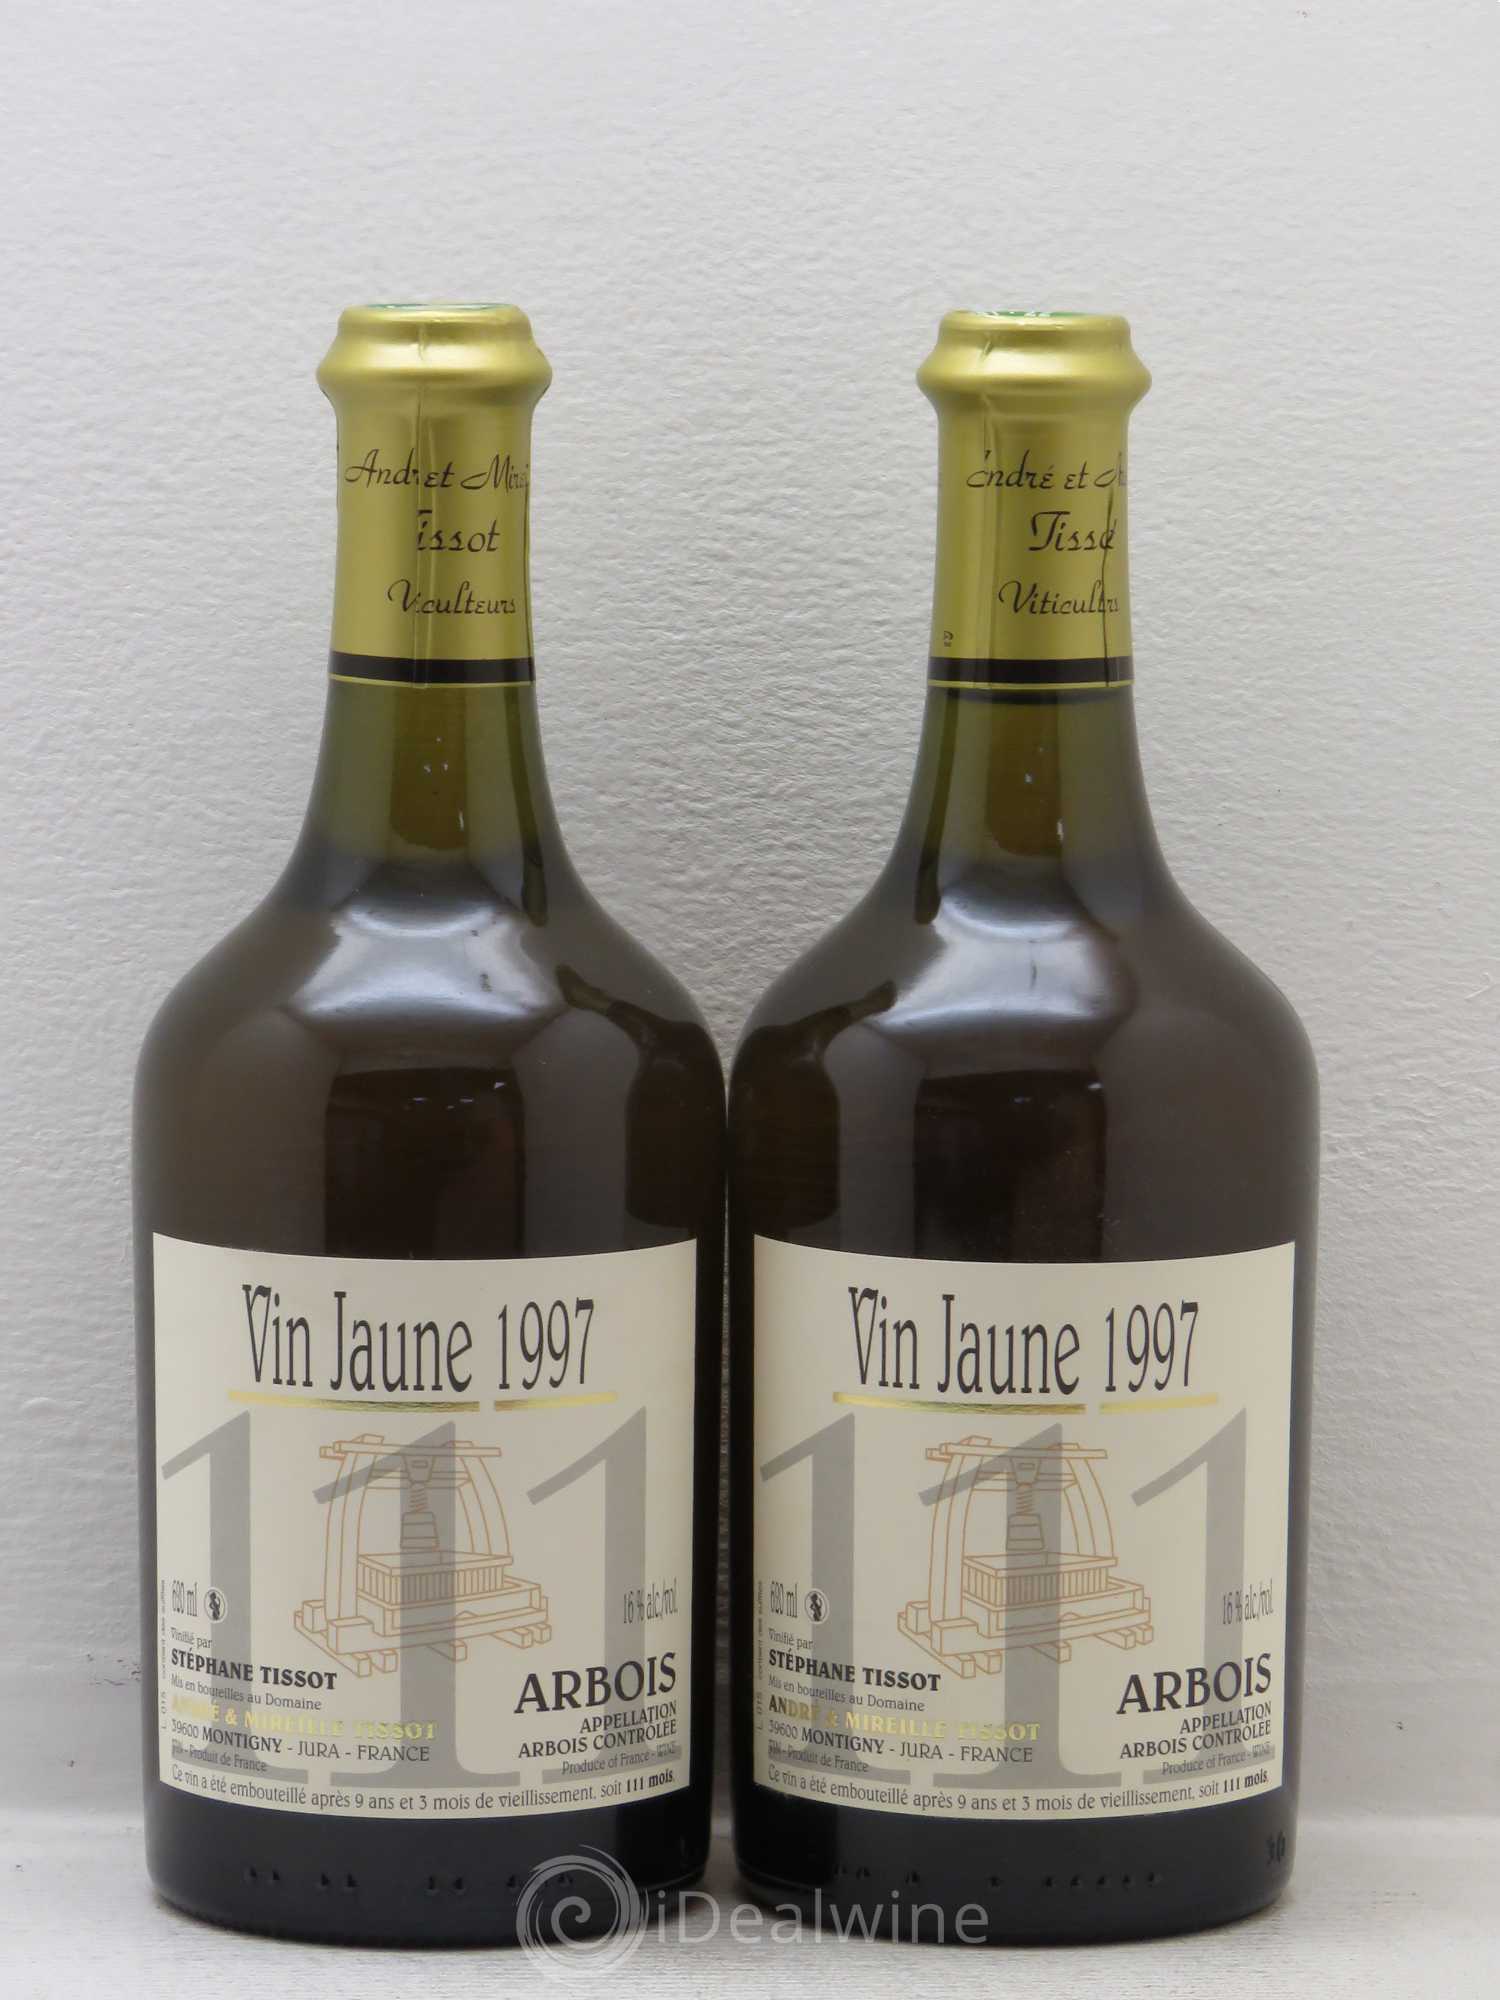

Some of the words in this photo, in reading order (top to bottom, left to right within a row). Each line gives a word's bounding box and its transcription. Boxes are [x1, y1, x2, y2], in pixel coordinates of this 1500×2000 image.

[344, 448, 420, 487] Andr
[424, 462, 454, 489] et
[1064, 461, 1088, 489] et
[242, 1283, 313, 1387] Vin
[329, 1291, 473, 1392] Jaune
[497, 1297, 594, 1390] 1997
[848, 1286, 920, 1390] Vin
[937, 1294, 1080, 1395] Jaune
[1105, 1300, 1199, 1392] 1997
[186, 1582, 198, 1617] ml
[624, 1590, 634, 1623] 16
[786, 1582, 798, 1618] ml
[1223, 1591, 1232, 1624] 16
[196, 1638, 213, 1650] par
[796, 1638, 814, 1650] par
[171, 1647, 253, 1682] STÉPHANE
[260, 1665, 337, 1690] TISSOT
[514, 1652, 676, 1714] ARBOIS
[768, 1648, 855, 1683] STÉPHANE
[862, 1666, 941, 1691] TISSOT
[1116, 1653, 1272, 1714] ARBOIS
[171, 1673, 184, 1689] Mis
[185, 1679, 196, 1692] en
[197, 1682, 244, 1704] bouteilles
[247, 1691, 261, 1704] au
[265, 1693, 322, 1710] Domaine
[768, 1674, 782, 1690] Mis
[784, 1680, 795, 1692] en
[797, 1682, 845, 1704] bouteilles
[849, 1692, 863, 1705] au
[867, 1694, 925, 1711] Domaine
[224, 1707, 238, 1727] &
[580, 1700, 677, 1734] APPELLATION
[845, 1711, 946, 1738] MIREILLE
[1180, 1701, 1272, 1735] APPELLATION
[171, 1718, 199, 1739] 39600
[201, 1726, 283, 1754] MONTIGNY
[296, 1742, 340, 1760] JURA
[357, 1745, 430, 1762] FRANCE
[518, 1736, 588, 1758] ARBOIS
[768, 1719, 798, 1739] 39600
[801, 1727, 884, 1754] MONTIGNY
[899, 1742, 943, 1760] JURA
[960, 1745, 1033, 1763] FRANCE
[1119, 1736, 1187, 1759] ARBOIS
[220, 1753, 231, 1767] de
[234, 1755, 267, 1772] France
[562, 1756, 605, 1775] Produce
[607, 1752, 618, 1769] of
[620, 1750, 649, 1768] France
[821, 1754, 832, 1767] de
[834, 1755, 869, 1772] France
[1162, 1756, 1204, 1775] Produce
[1206, 1752, 1216, 1769] of
[1218, 1750, 1246, 1767] France
[172, 1763, 183, 1783] Ce
[185, 1770, 199, 1786] vin
[201, 1776, 208, 1789] a
[210, 1775, 227, 1793] été
[230, 1782, 306, 1805] embouteillé
[311, 1791, 350, 1811] après
[355, 1795, 364, 1809] 9
[368, 1797, 395, 1810] ans
[400, 1795, 413, 1810] et
[419, 1795, 428, 1810] 3
[433, 1793, 470, 1810] mois
[475, 1791, 494, 1809] de
[600, 1781, 622, 1799] soit
[626, 1777, 645, 1793] 111
[768, 1763, 779, 1783] Ce
[782, 1770, 797, 1786] vin
[800, 1776, 807, 1790] a
[809, 1776, 827, 1794] été
[830, 1782, 909, 1806] embouteillé
[913, 1792, 953, 1812] après
[958, 1795, 967, 1810] 9
[971, 1797, 998, 1810] ans
[1002, 1796, 1016, 1811] et
[1021, 1795, 1031, 1811] 3
[1036, 1793, 1072, 1811] mois
[1077, 1791, 1095, 1810] de
[1199, 1781, 1219, 1799] soit
[1223, 1777, 1240, 1794] 111
